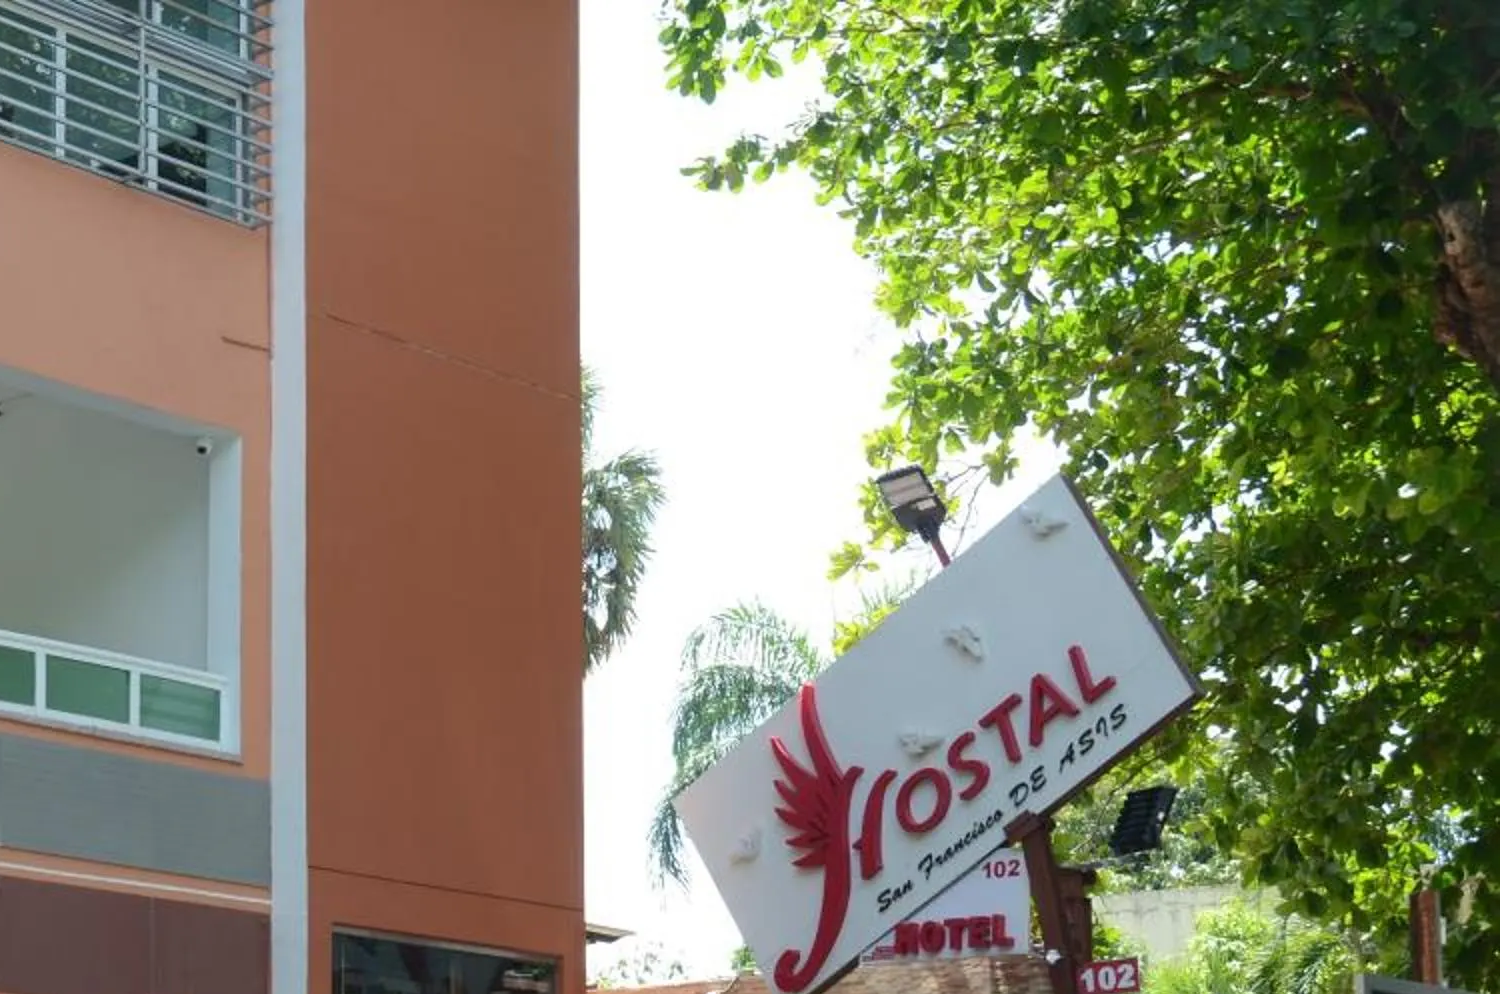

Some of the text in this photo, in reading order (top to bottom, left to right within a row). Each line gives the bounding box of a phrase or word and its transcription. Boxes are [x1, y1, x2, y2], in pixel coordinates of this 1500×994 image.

[772, 645, 1117, 993] HOSTAL
[877, 880, 914, 913] San
[918, 809, 1004, 880] Francisco
[1009, 765, 1047, 807] DE
[982, 859, 1021, 879] 102
[894, 914, 1015, 957] HOTEL
[1080, 963, 1137, 993] 102
